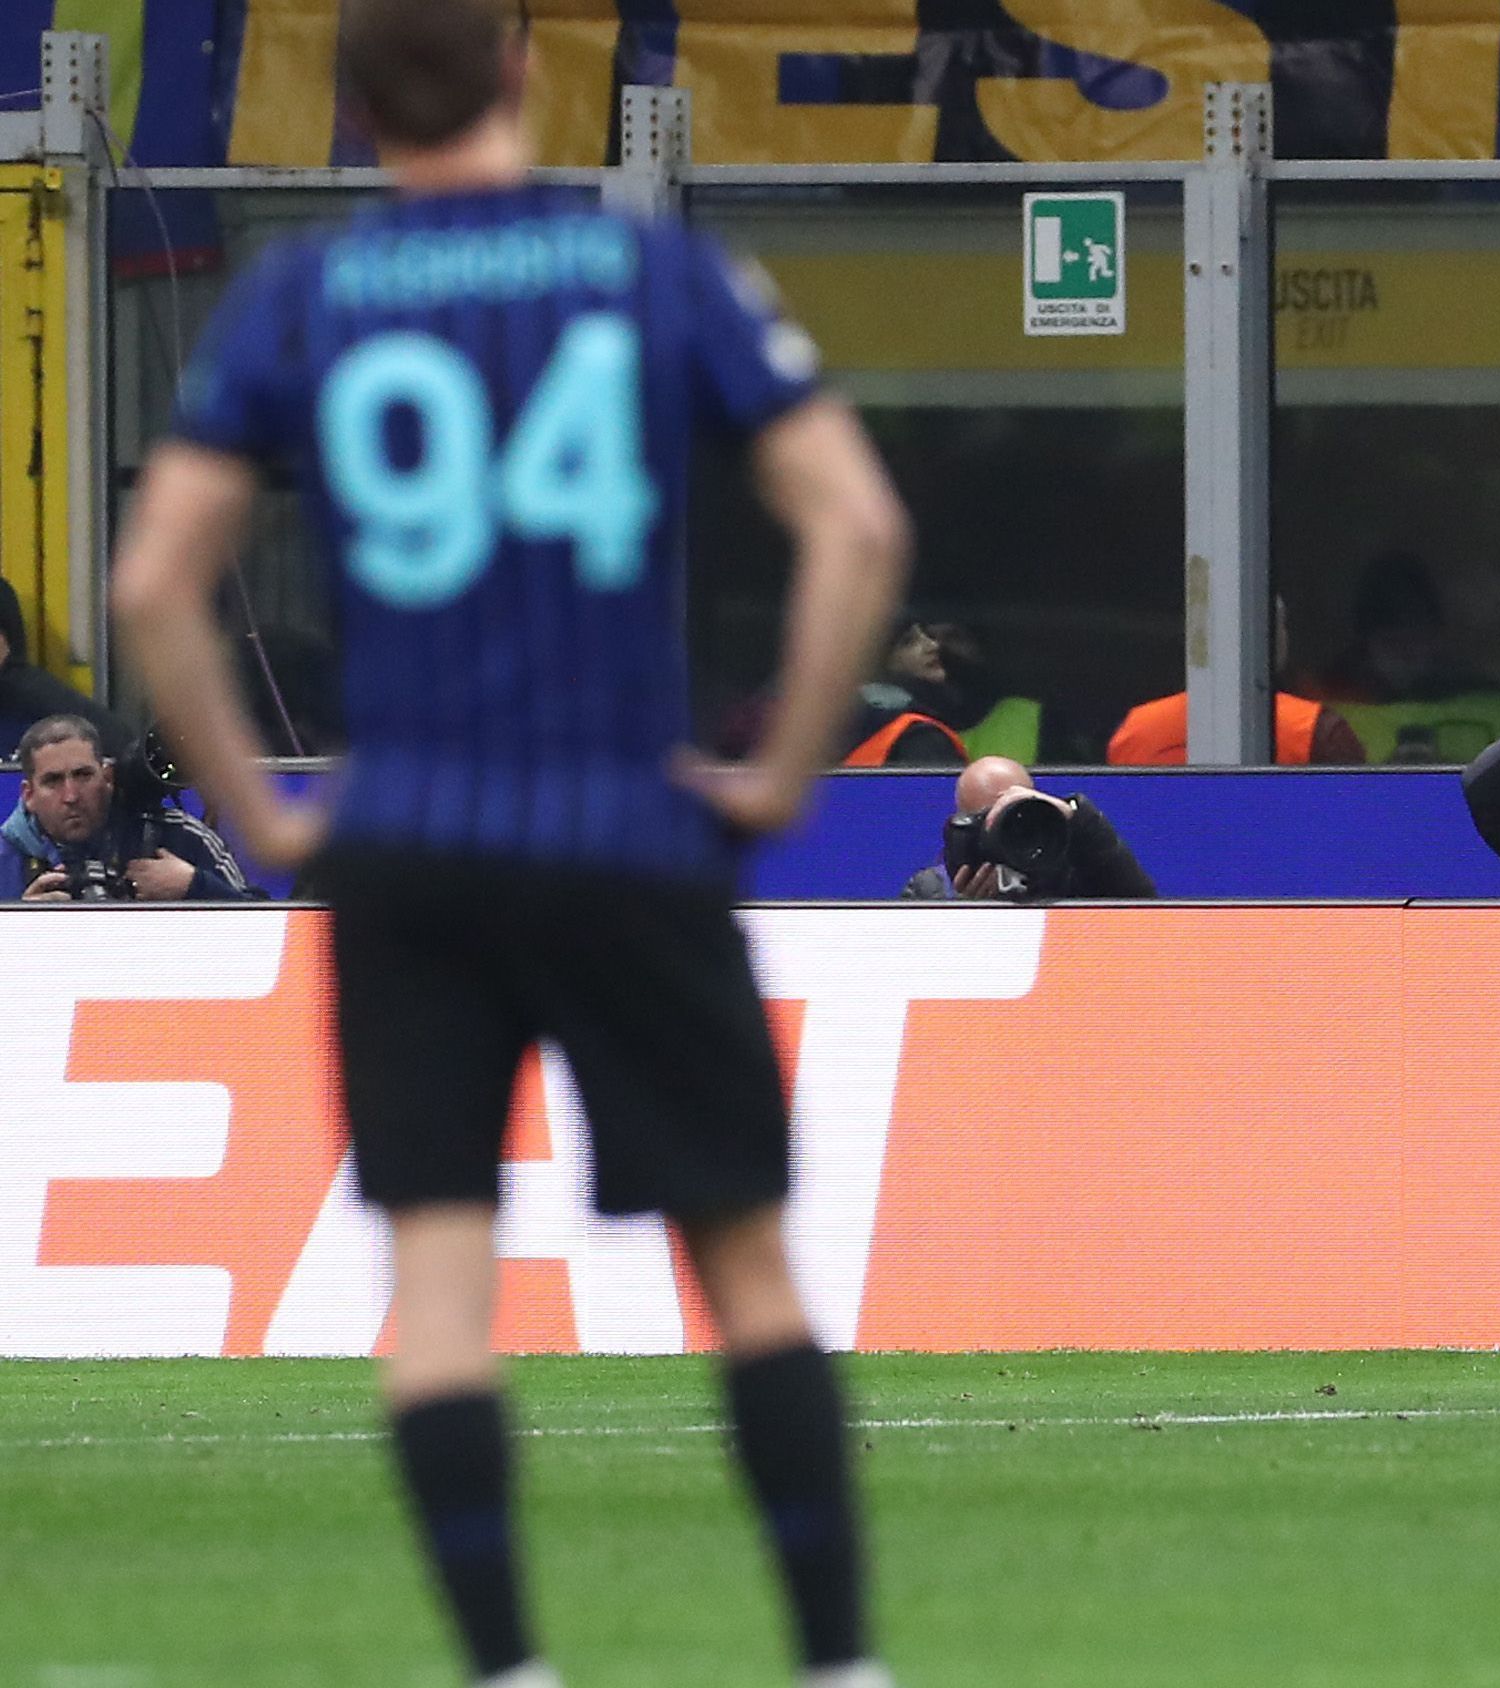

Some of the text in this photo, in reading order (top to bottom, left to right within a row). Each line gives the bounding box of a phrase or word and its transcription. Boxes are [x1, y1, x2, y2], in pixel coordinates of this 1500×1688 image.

[1038, 302, 1111, 313] USCITA DI
[1030, 316, 1118, 328] EMERGENZA
[1296, 316, 1351, 350] EXIT
[316, 308, 660, 608] 94
